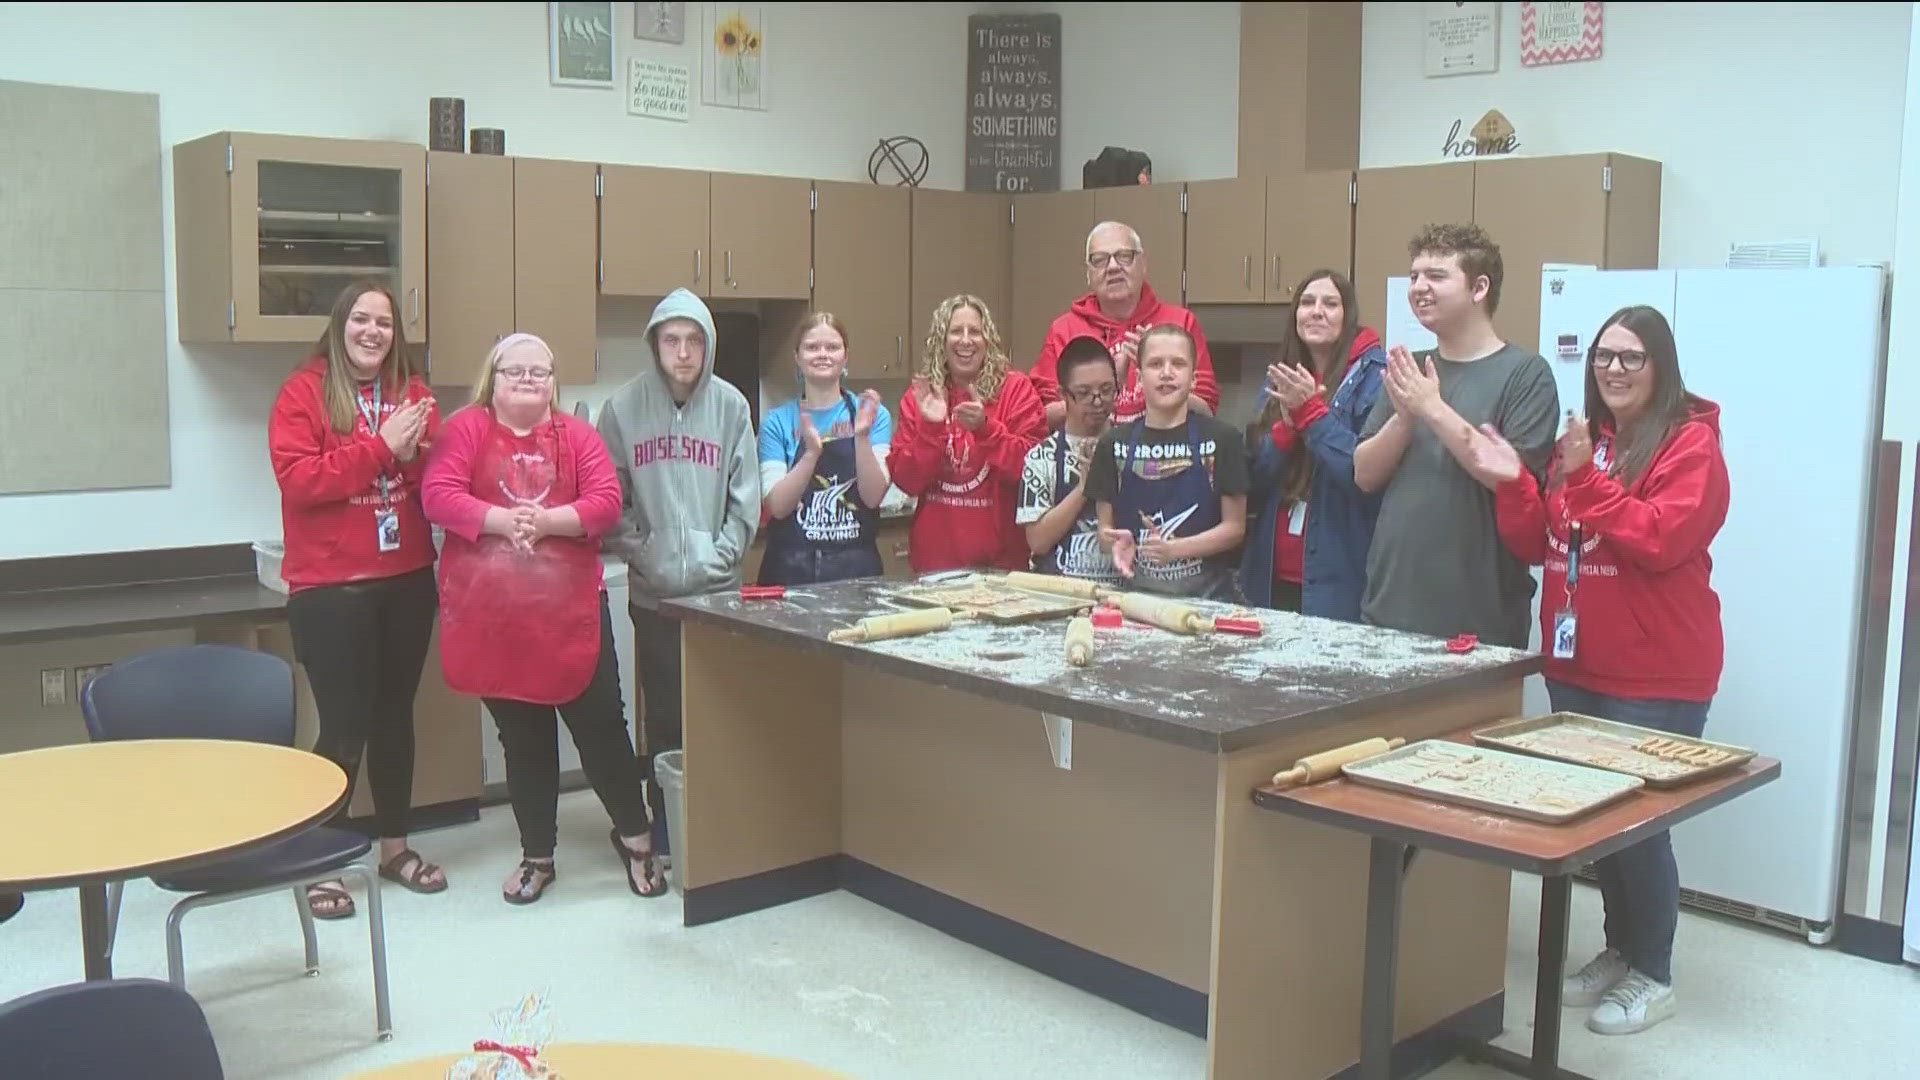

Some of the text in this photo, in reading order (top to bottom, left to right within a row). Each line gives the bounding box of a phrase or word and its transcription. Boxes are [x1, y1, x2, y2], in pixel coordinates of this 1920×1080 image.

[976, 28, 1029, 49] There
[651, 84, 677, 99] make
[643, 98, 668, 113] good
[973, 116, 1057, 137] SOMETHING
[1442, 118, 1521, 158] home
[634, 435, 678, 467] BOISE
